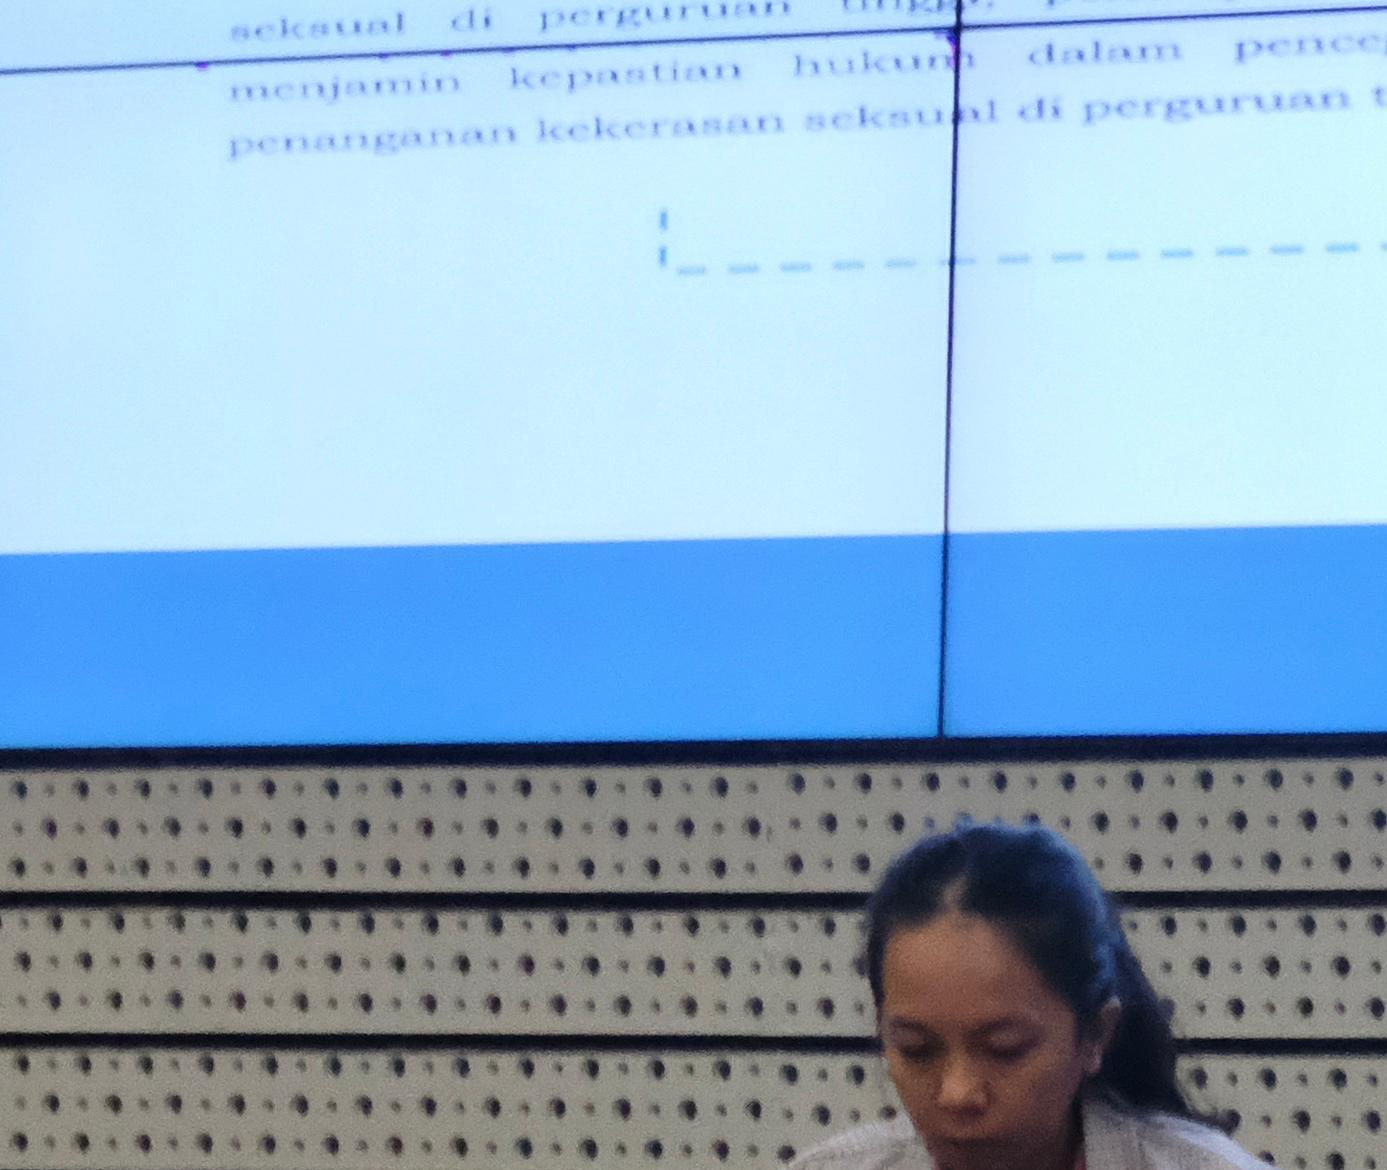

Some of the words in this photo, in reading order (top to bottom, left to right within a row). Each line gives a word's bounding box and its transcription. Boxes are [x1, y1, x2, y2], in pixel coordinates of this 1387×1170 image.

[451, 8, 494, 33] di
[230, 75, 461, 105] menjamin
[510, 57, 742, 94] kepastian
[1028, 40, 1183, 65] dalam
[229, 128, 517, 162] penanganan
[537, 110, 784, 143] kekerasan
[805, 98, 998, 131] seksual
[1017, 98, 1062, 124] di
[1083, 88, 1350, 126] perguruan
